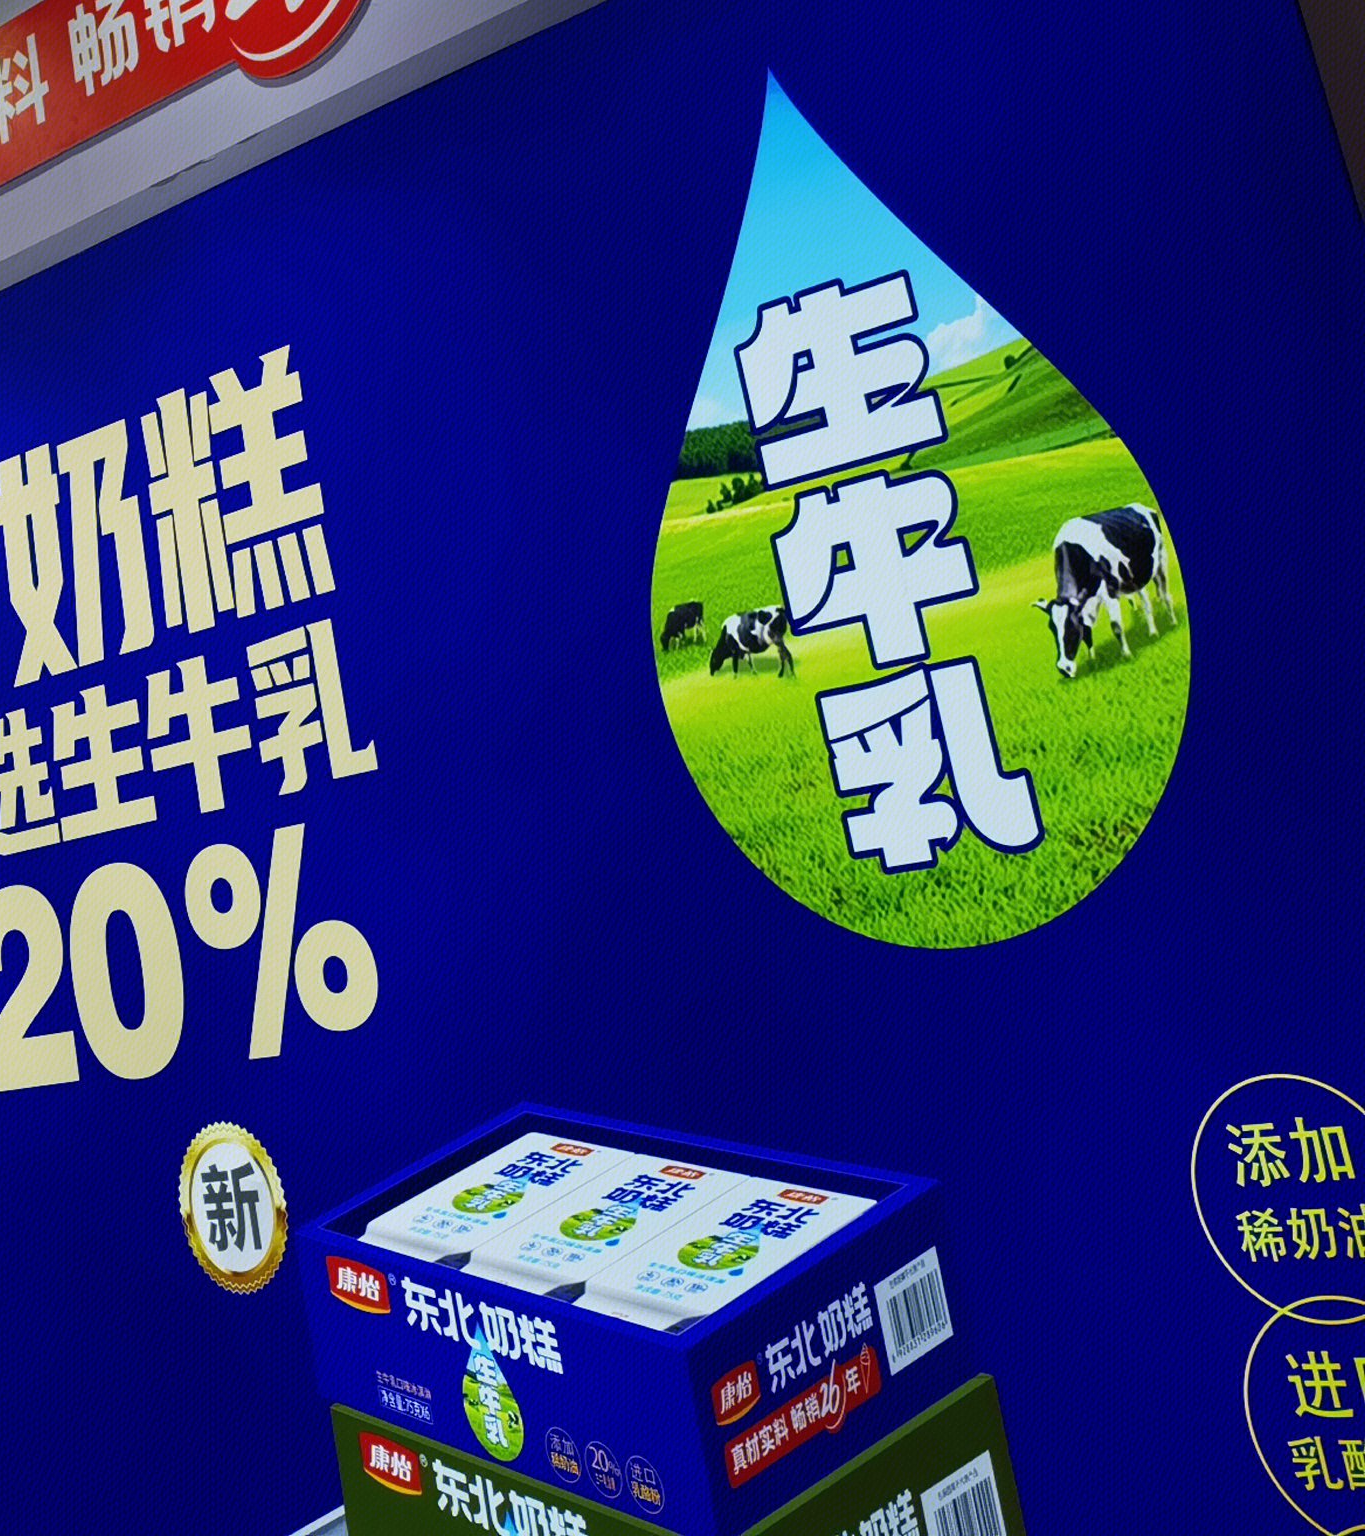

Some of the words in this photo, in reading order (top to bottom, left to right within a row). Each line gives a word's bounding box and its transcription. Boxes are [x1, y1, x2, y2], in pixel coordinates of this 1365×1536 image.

[734, 270, 1045, 874] 生牛乳
[516, 1152, 583, 1173] 东北
[1225, 1117, 1356, 1187] 添加
[494, 1164, 565, 1186] 奶糕
[625, 1174, 695, 1198] 东北
[201, 1160, 263, 1255] 新
[601, 1187, 678, 1212] 奶糕
[741, 1199, 819, 1224] 东北
[719, 1212, 801, 1239] 奶糕
[337, 1266, 380, 1301] 康怡
[401, 1276, 564, 1375] 东北奶糕
[765, 1281, 874, 1394] 东北奶糕
[473, 1354, 509, 1449] 生牛乳
[720, 1371, 752, 1414] 康怡
[1285, 1350, 1365, 1418] 进
[370, 1443, 412, 1482] 康怡
[588, 1445, 621, 1477] 20%
[731, 1414, 789, 1475] 真材实料
[630, 1461, 656, 1485] 进口
